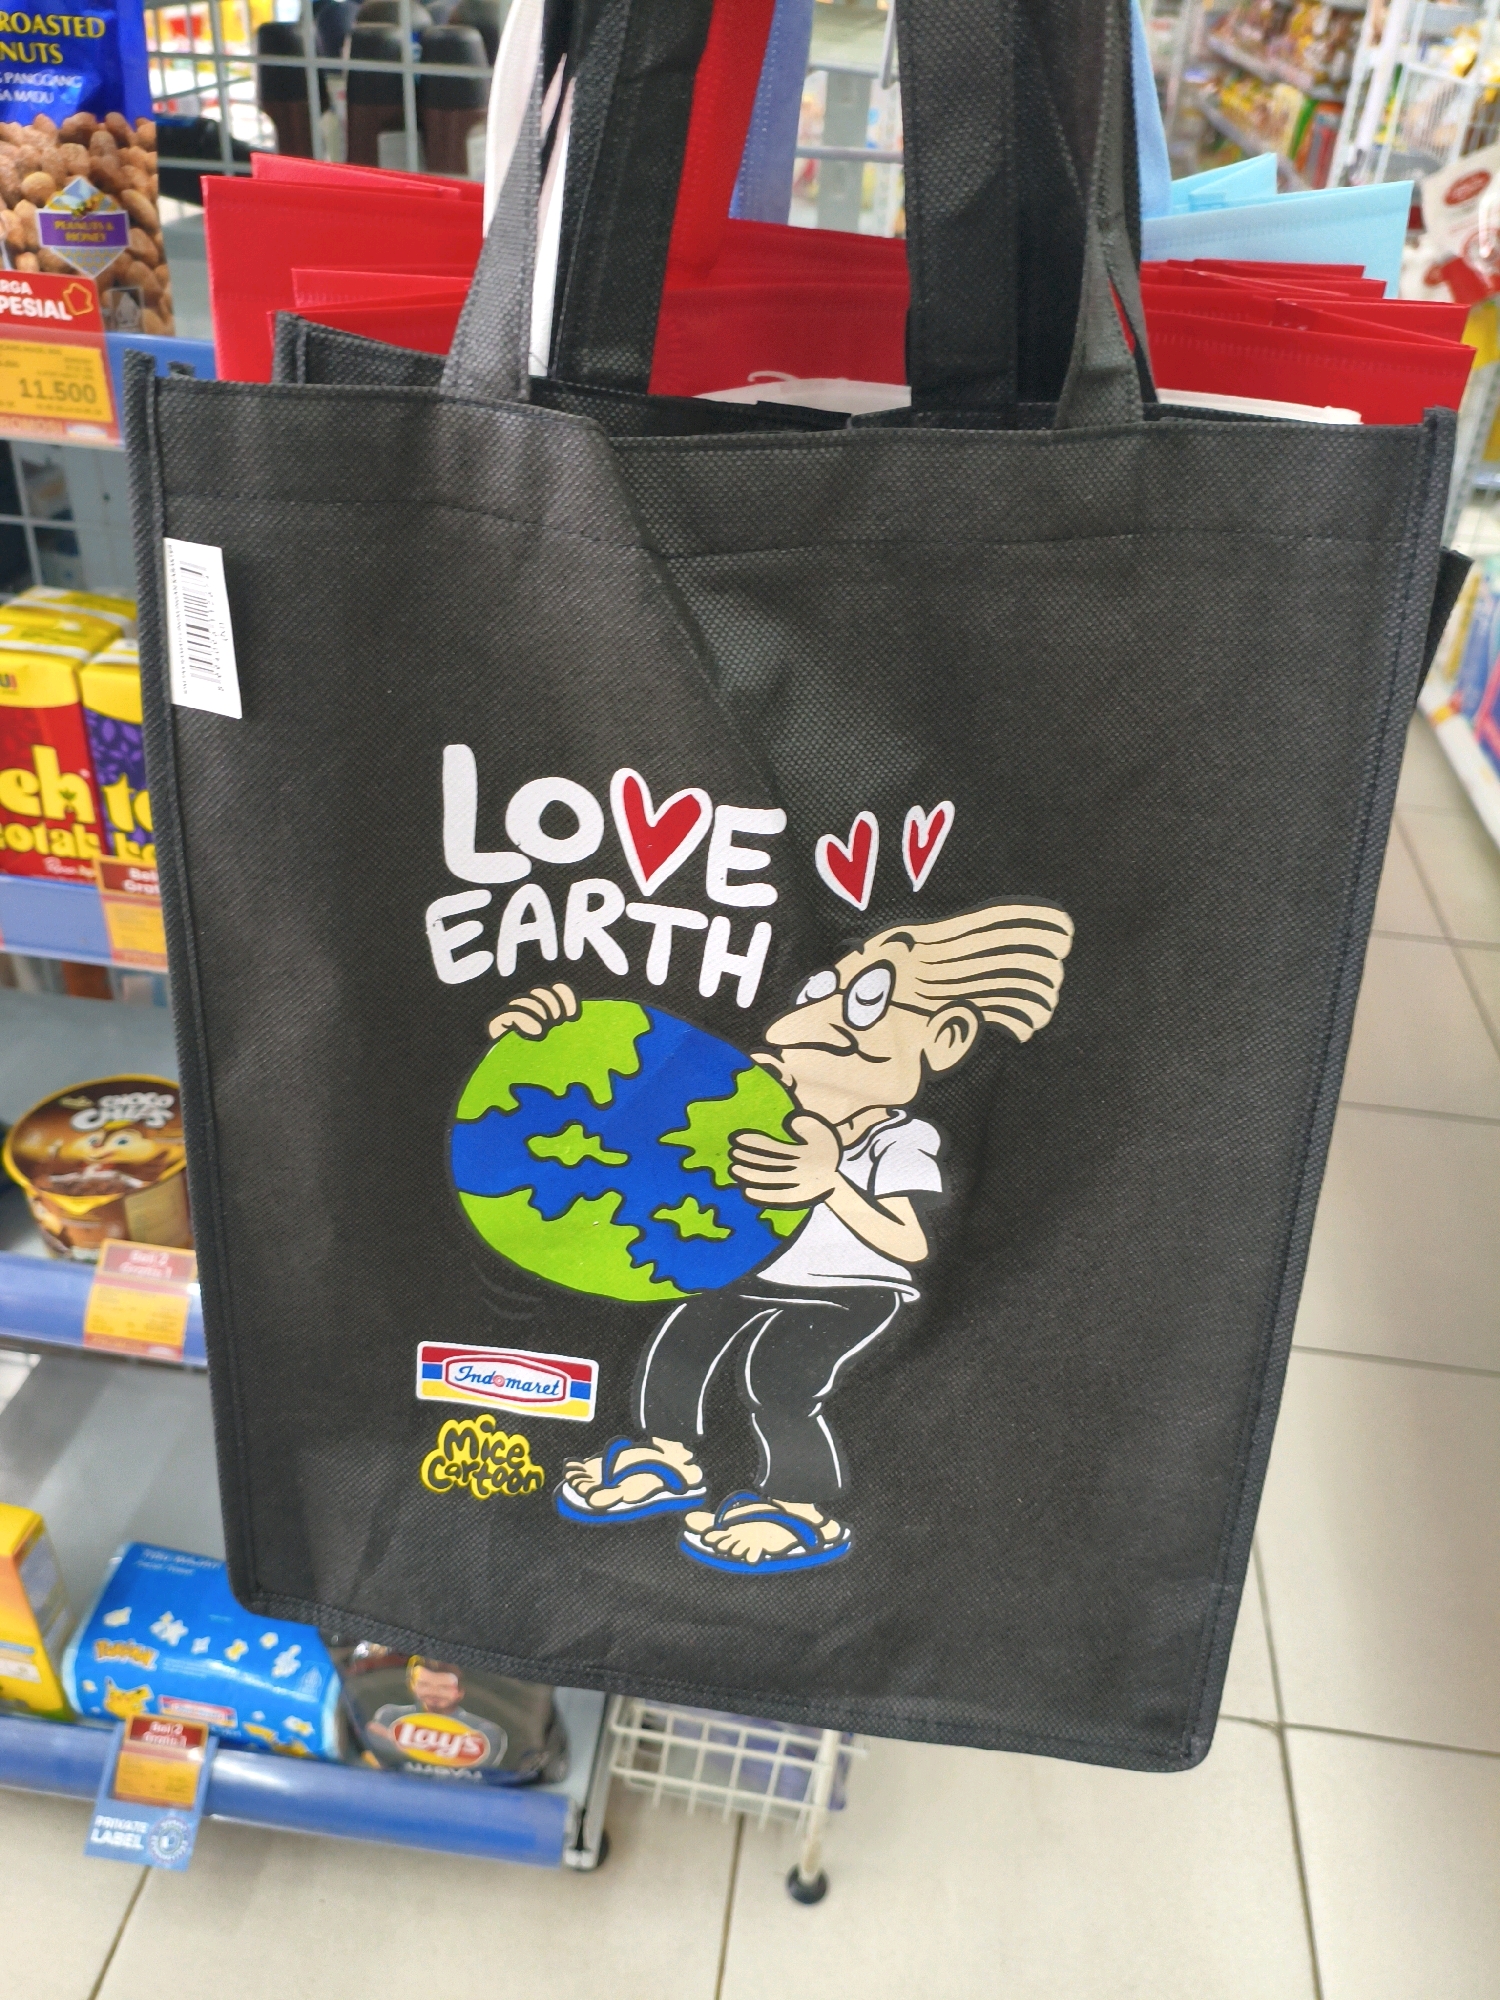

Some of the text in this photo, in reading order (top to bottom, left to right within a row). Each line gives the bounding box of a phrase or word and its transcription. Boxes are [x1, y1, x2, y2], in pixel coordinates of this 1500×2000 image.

[0, 11, 106, 38] ROASTED
[19, 378, 97, 404] 11.500
[0, 821, 101, 860] otak
[443, 744, 787, 907] LOVE
[425, 879, 772, 1008] EARTH
[455, 1366, 560, 1396] Indomaret
[438, 1414, 531, 1470] Mice
[420, 1450, 545, 1500] Cartoon
[398, 1722, 484, 1759] Lay's
[90, 1828, 145, 1850] LABEL
[94, 1814, 149, 1834] PRIVATE
